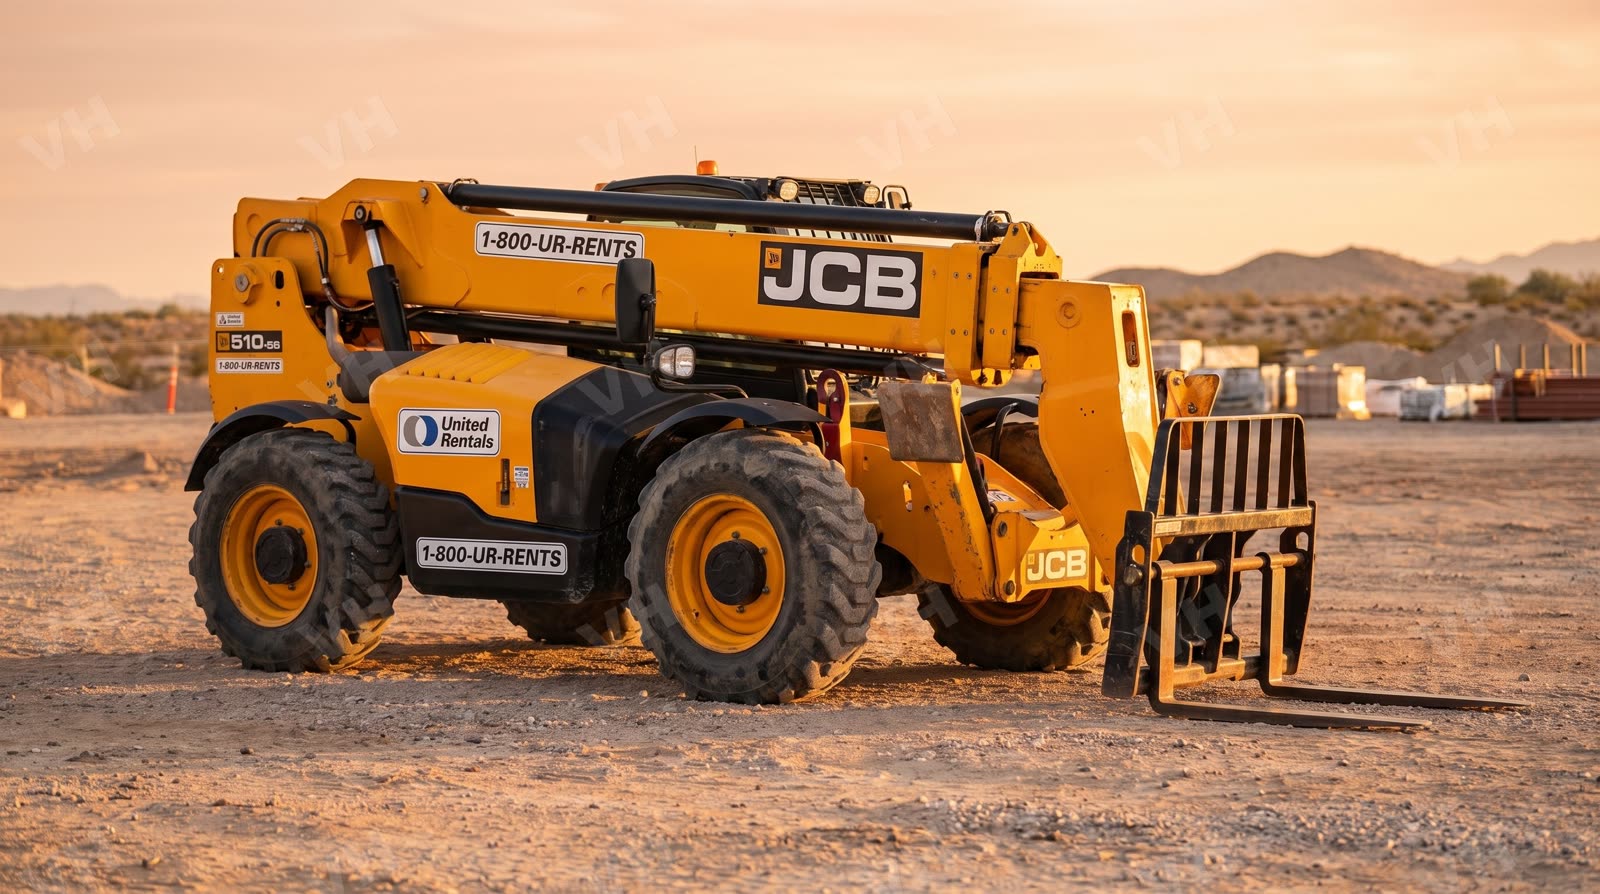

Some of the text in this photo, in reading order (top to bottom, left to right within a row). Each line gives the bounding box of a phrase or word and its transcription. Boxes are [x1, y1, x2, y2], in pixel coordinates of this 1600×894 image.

[482, 230, 637, 259] 1-800-UR-RENTS
[763, 249, 917, 310] JCB
[219, 361, 281, 371] 1-800-UR-RENTS
[441, 416, 490, 432] United
[440, 432, 494, 449] Rentals
[422, 545, 562, 567] 1-800-UR-RENTS
[1026, 549, 1087, 581] JCB
